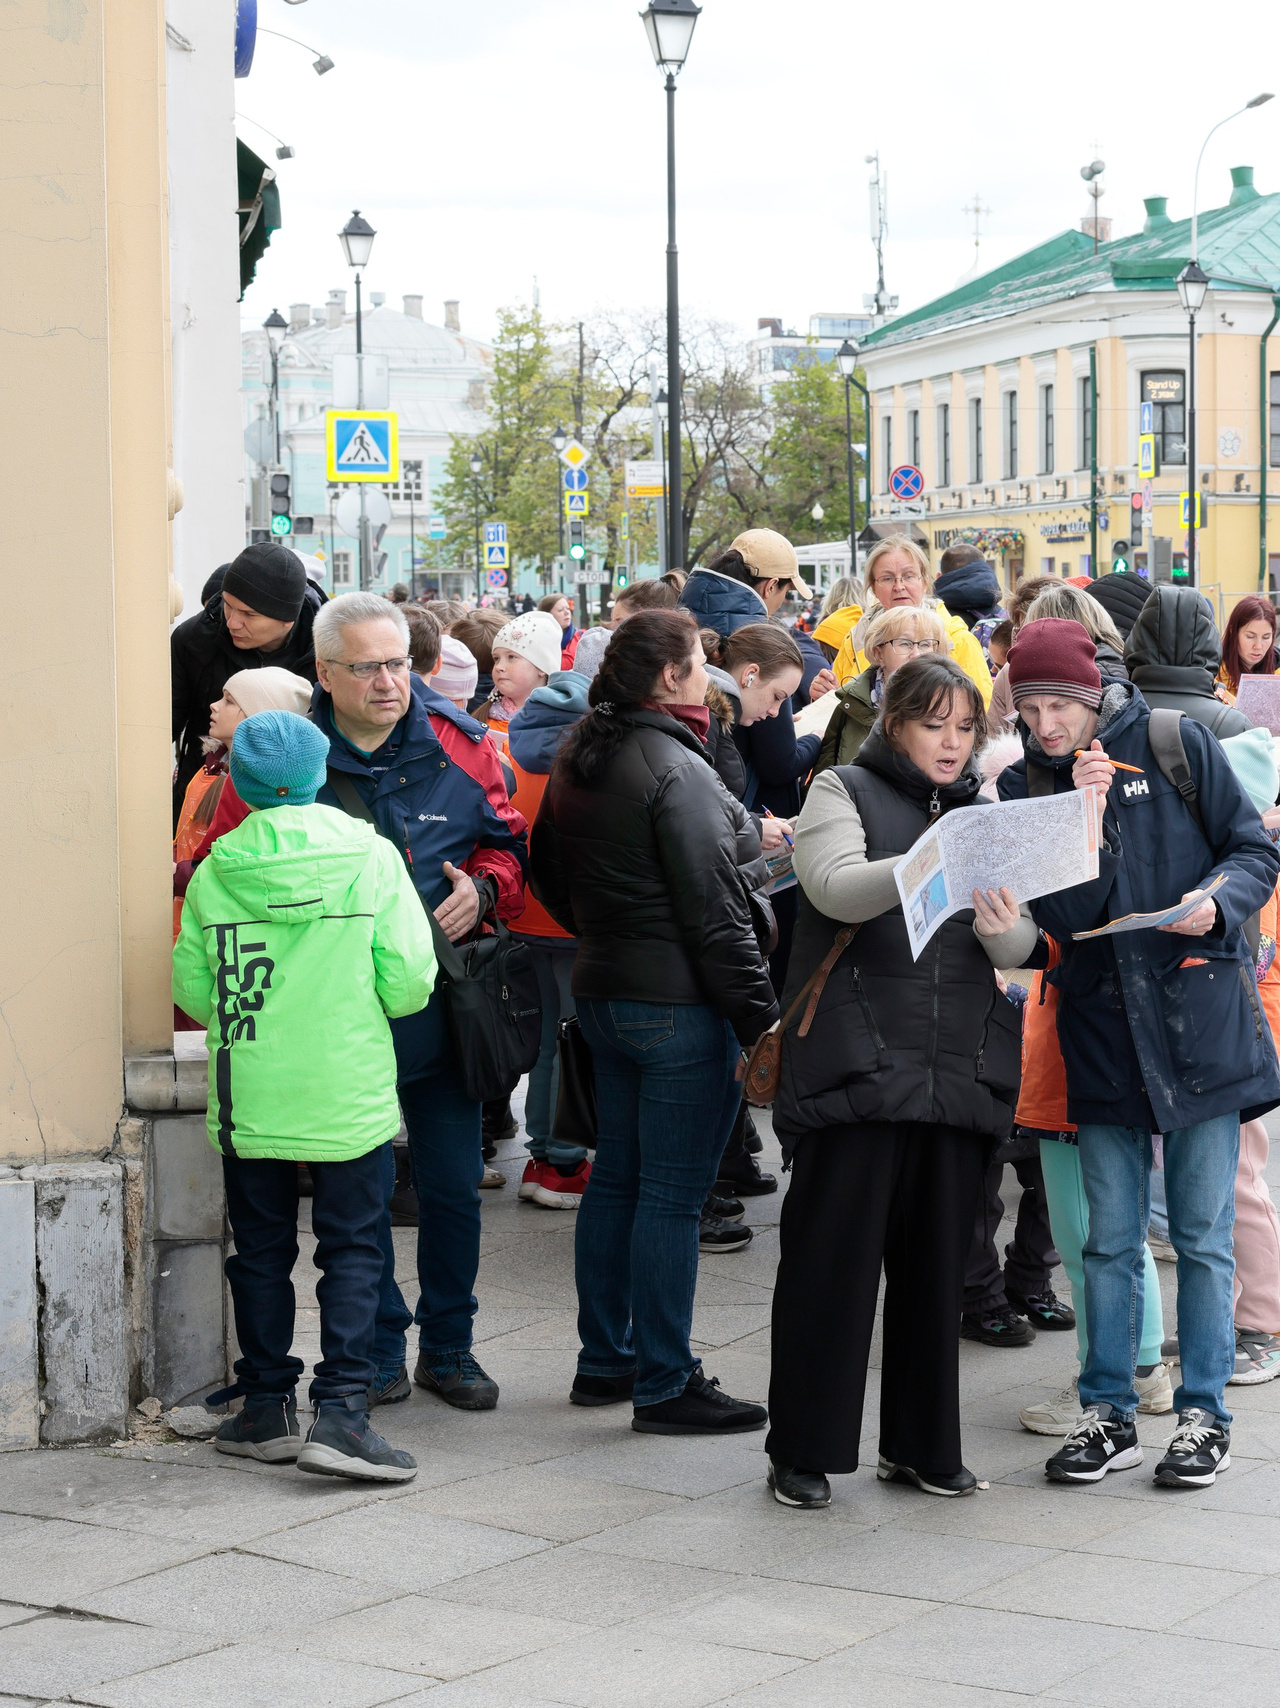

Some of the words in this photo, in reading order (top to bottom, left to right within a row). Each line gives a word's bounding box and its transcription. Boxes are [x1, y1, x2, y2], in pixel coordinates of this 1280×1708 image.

[1146, 380, 1168, 390] Stand
[1169, 380, 1180, 391] Up
[1151, 390, 1157, 399] 2
[578, 572, 605, 582] СТОП
[1123, 779, 1150, 798] HH
[426, 813, 448, 821] Columbia
